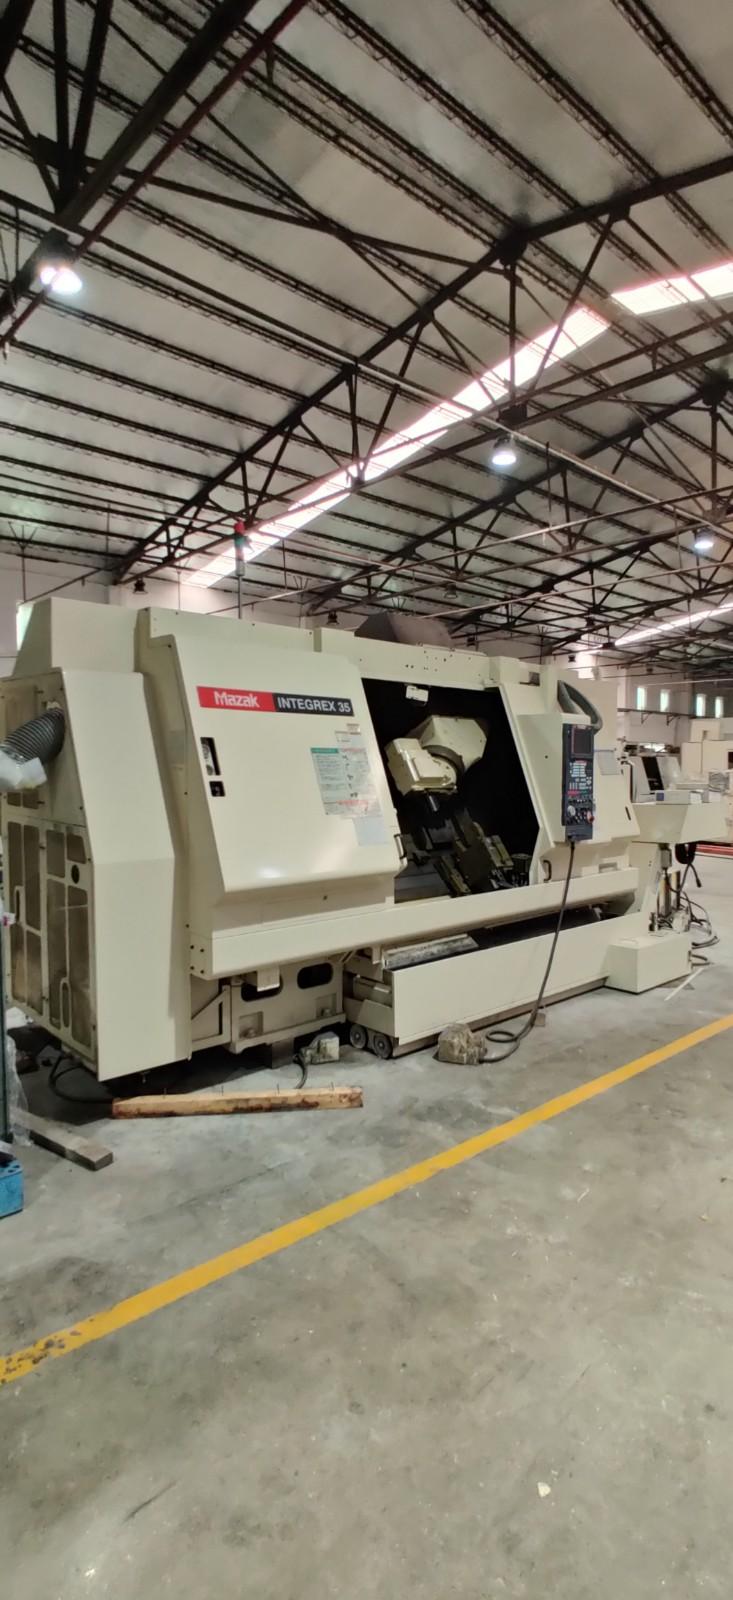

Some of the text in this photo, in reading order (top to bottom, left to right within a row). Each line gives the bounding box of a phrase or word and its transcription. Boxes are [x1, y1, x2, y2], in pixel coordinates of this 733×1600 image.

[214, 691, 351, 713] Mazak INTEGREX 35
